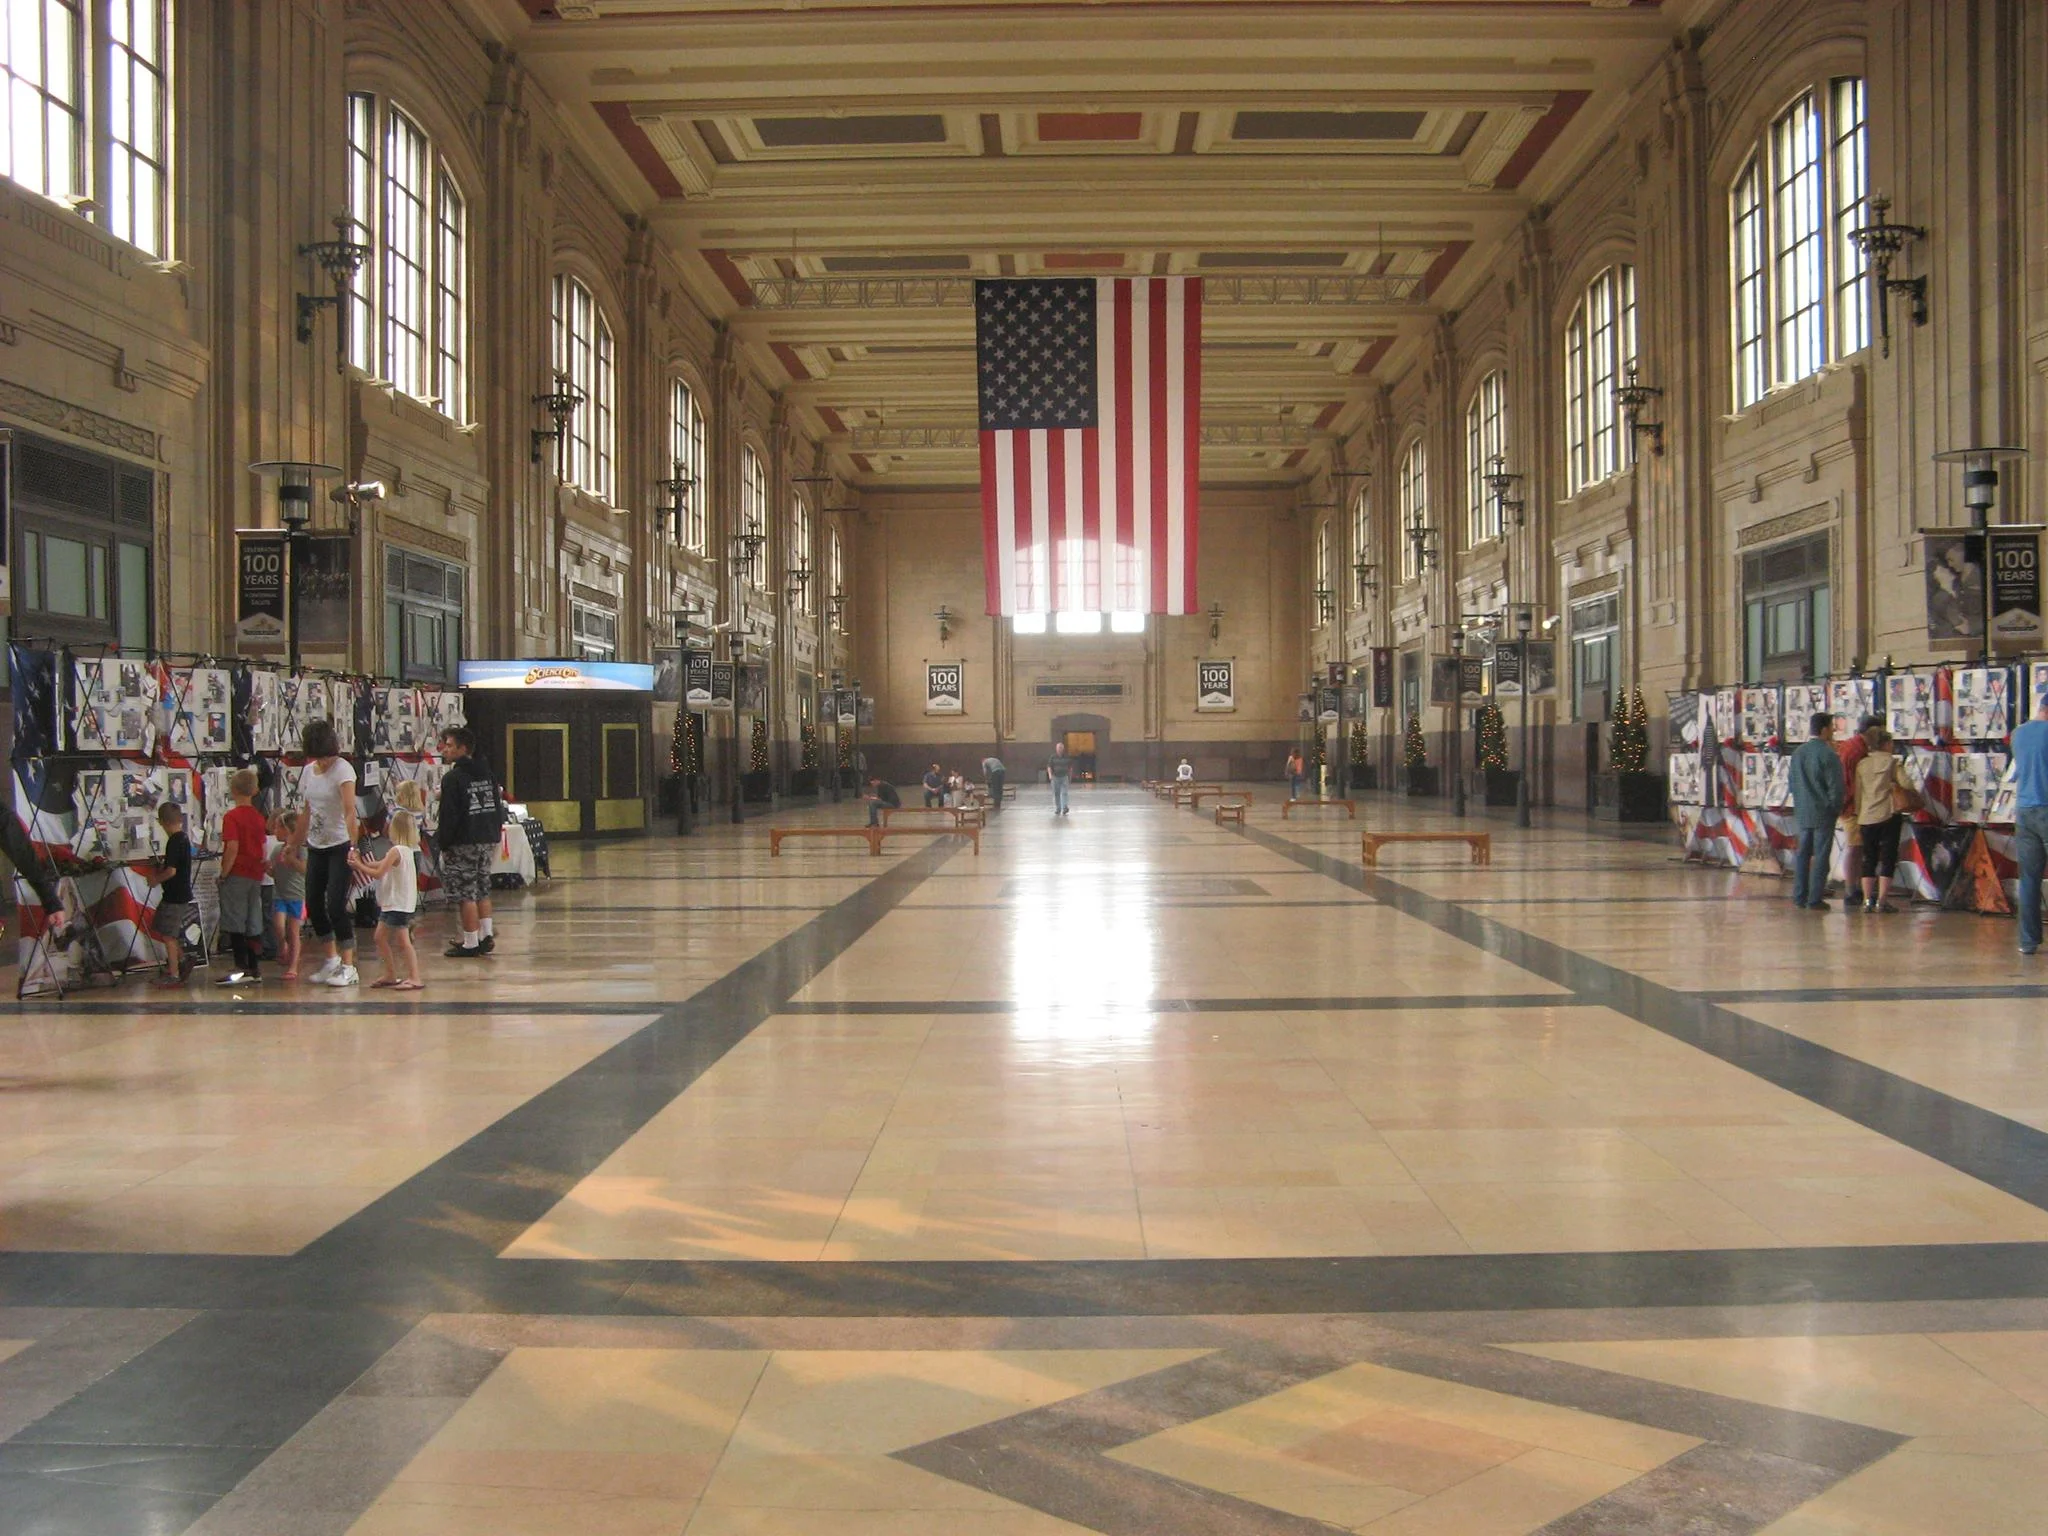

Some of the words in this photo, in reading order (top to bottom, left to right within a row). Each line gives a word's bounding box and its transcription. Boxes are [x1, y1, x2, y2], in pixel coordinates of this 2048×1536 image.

[243, 555, 280, 573] 100
[1995, 550, 2034, 569] 100
[244, 574, 279, 585] YEARS
[1997, 571, 2034, 581] YEARS
[691, 659, 709, 669] 100
[1464, 665, 1480, 674] 100
[714, 671, 731, 680] 100
[930, 672, 957, 685] 100
[1202, 669, 1229, 682] 100
[931, 684, 957, 692] YEARS
[1203, 681, 1229, 689] YEARS
